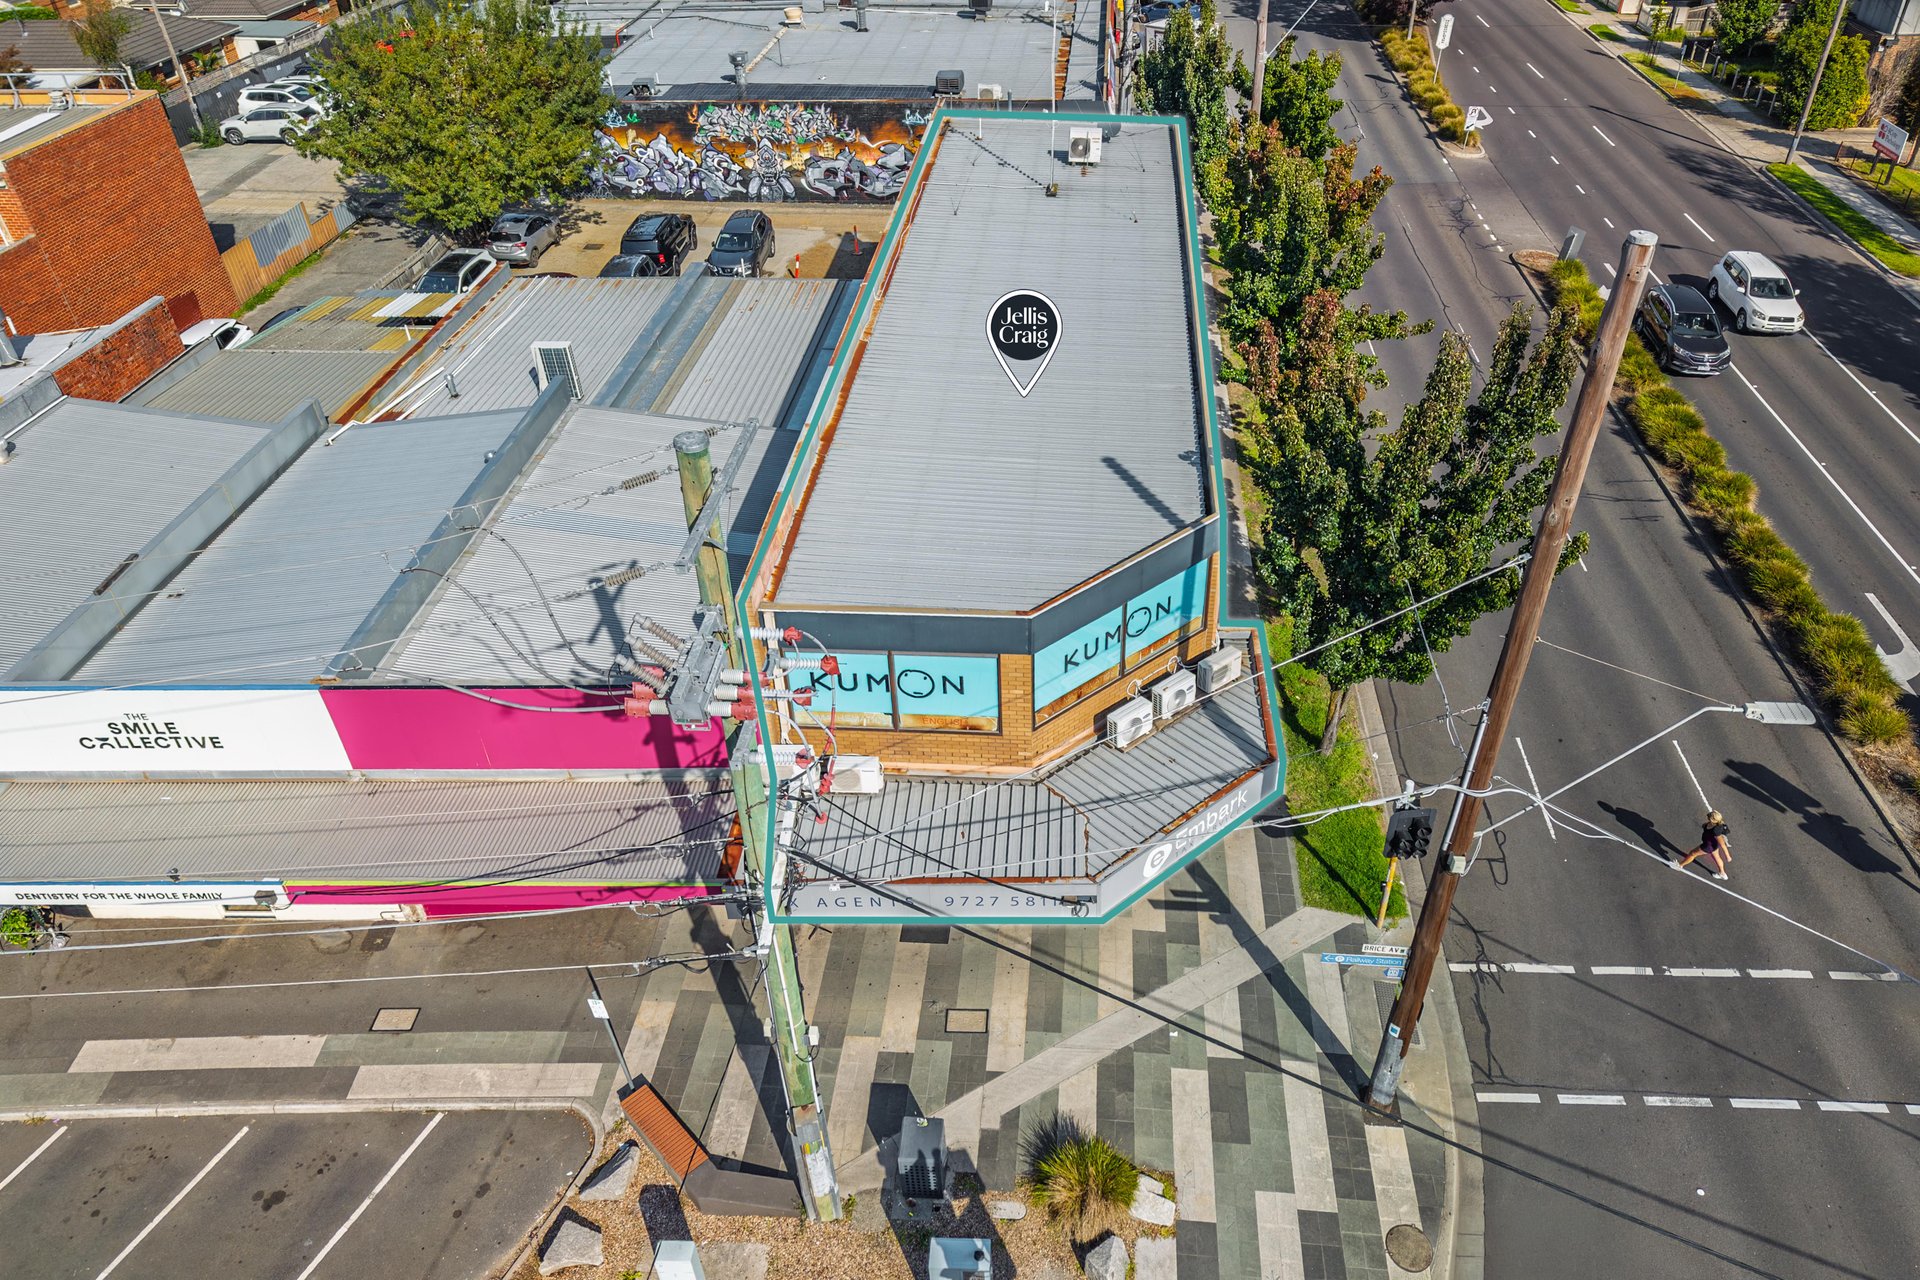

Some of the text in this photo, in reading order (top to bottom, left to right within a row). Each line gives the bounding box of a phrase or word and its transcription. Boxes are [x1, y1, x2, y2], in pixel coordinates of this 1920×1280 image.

[1064, 596, 1171, 673] KUMON
[810, 669, 964, 698] KUMON
[108, 722, 180, 735] SMILE
[79, 736, 224, 749] COLLECTIVE
[1175, 790, 1248, 850] Embark
[944, 896, 999, 907] 9727
